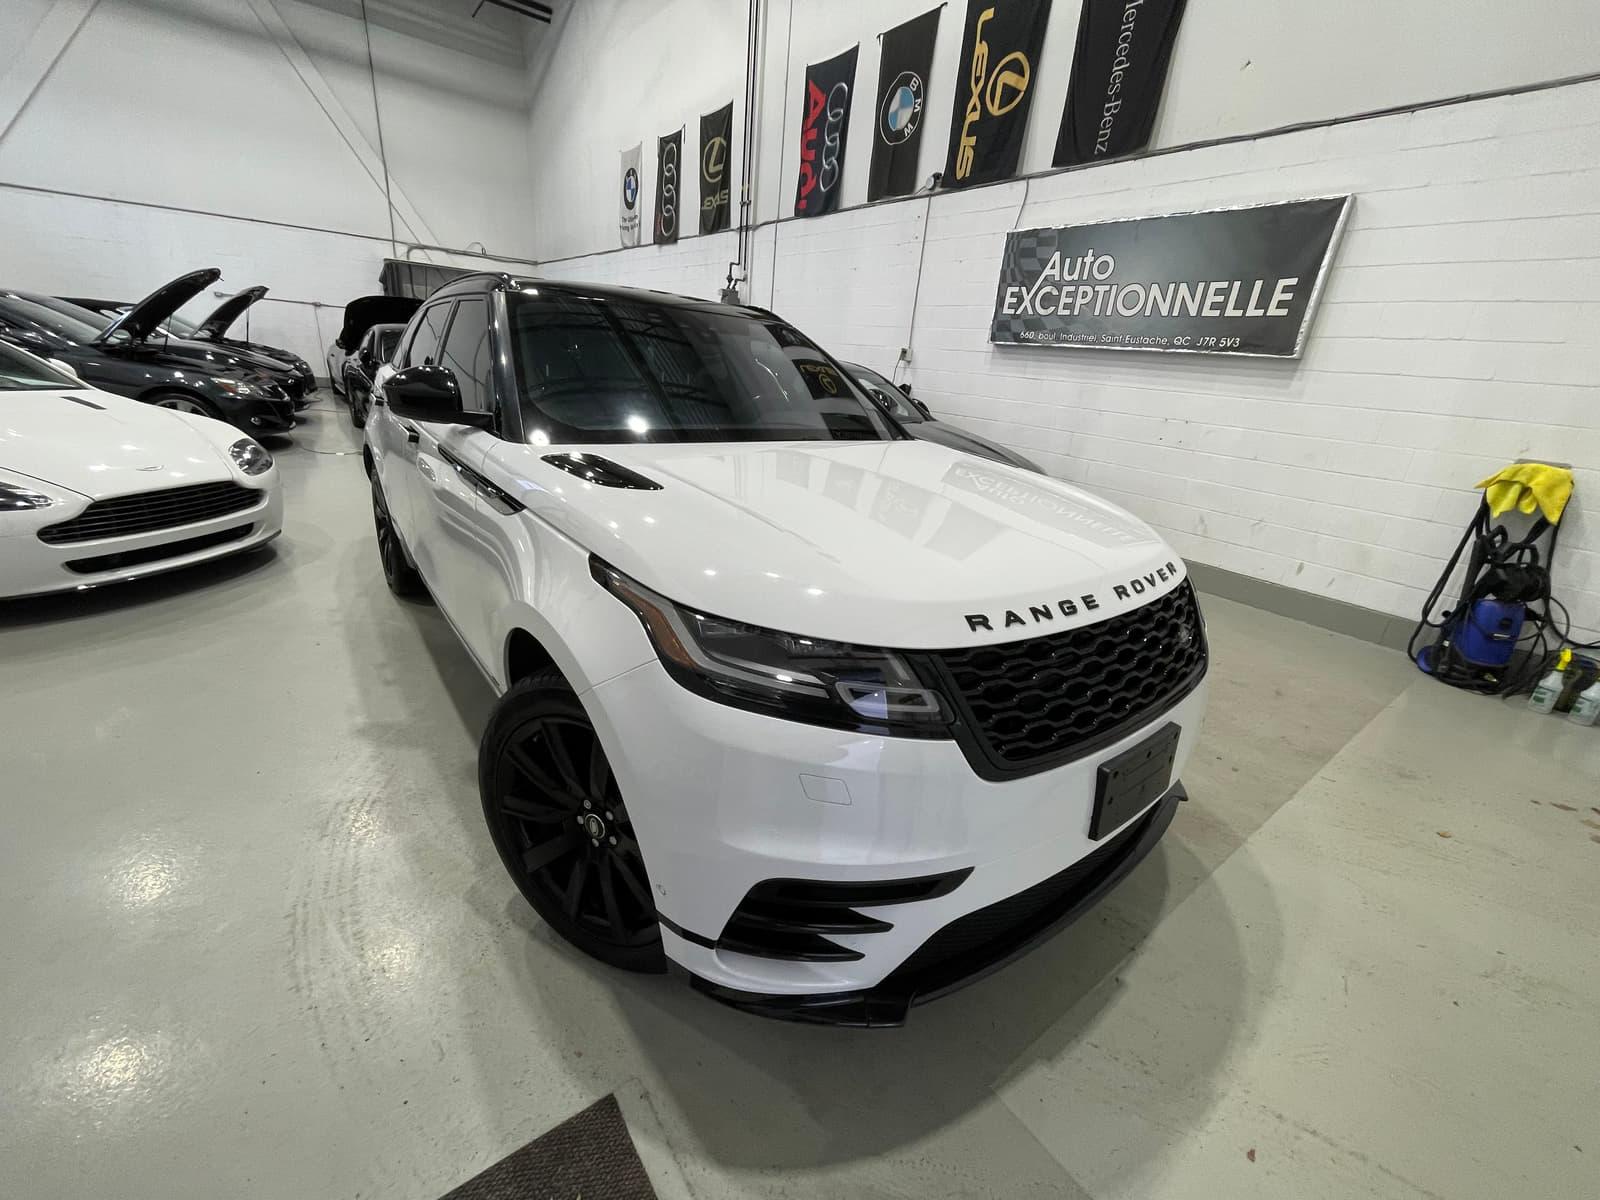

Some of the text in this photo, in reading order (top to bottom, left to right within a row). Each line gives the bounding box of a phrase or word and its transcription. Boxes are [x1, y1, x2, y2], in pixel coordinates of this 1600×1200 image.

[956, 7, 995, 180] LEXUS
[1037, 249, 1115, 284] Auto
[1002, 277, 1298, 317] EXCEPTIONNELLE
[1173, 336, 1192, 346] QC
[1196, 336, 1217, 347] J7R
[1218, 337, 1240, 348] 5V3
[964, 561, 1178, 632] RANGE ROVER
